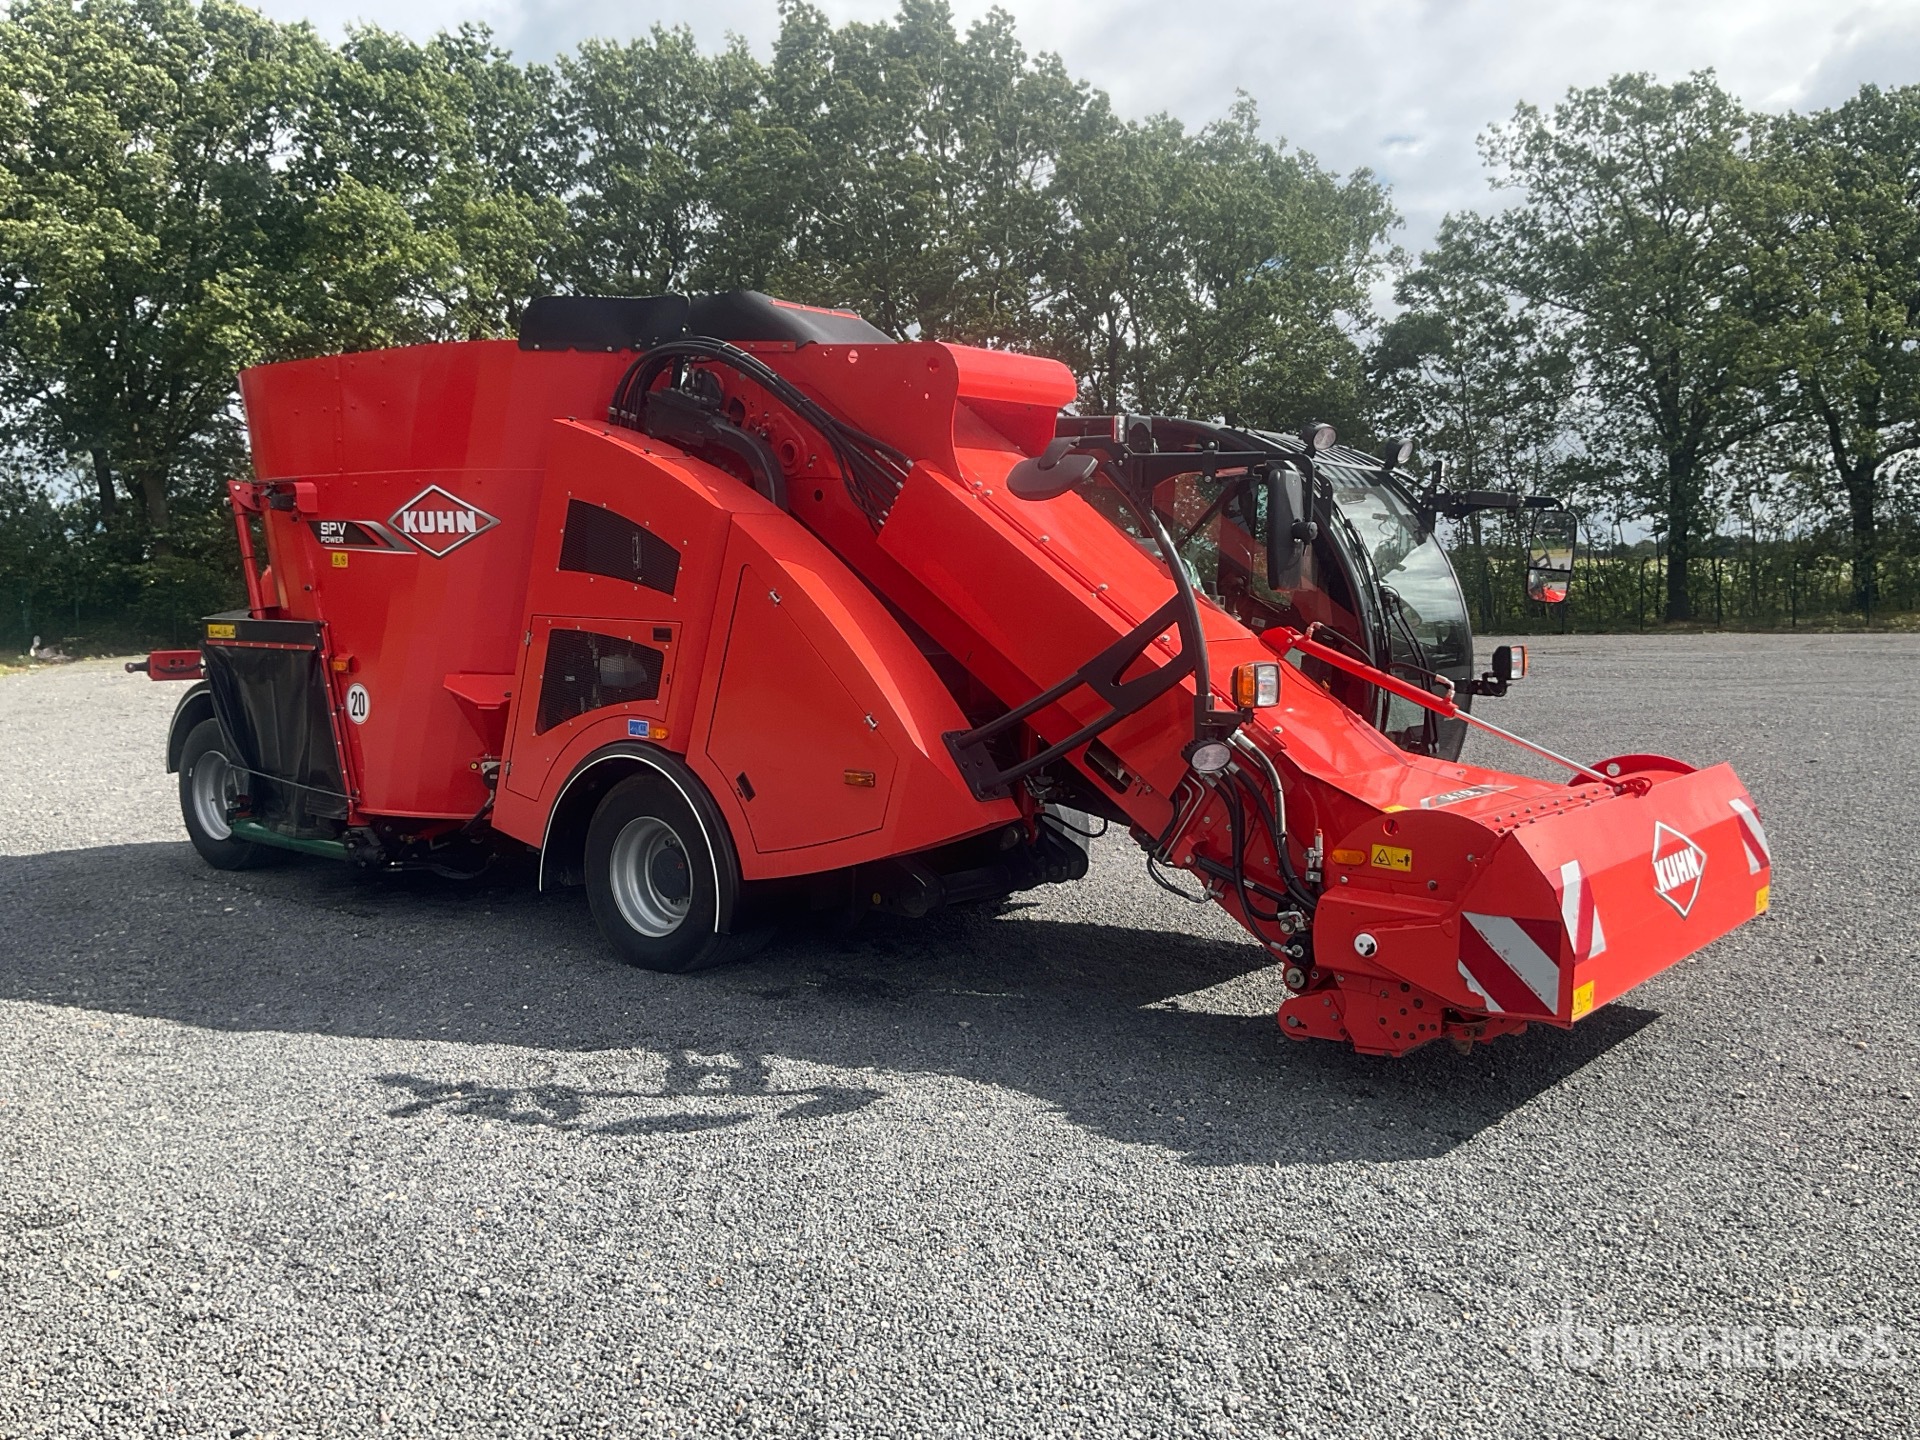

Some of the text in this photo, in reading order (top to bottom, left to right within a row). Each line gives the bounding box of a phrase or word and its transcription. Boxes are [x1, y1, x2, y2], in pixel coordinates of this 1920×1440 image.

[320, 522, 347, 535] SPV
[402, 510, 477, 533] KUHN
[320, 535, 345, 545] POWER
[351, 691, 366, 717] 20
[1653, 846, 1701, 893] KUHN
